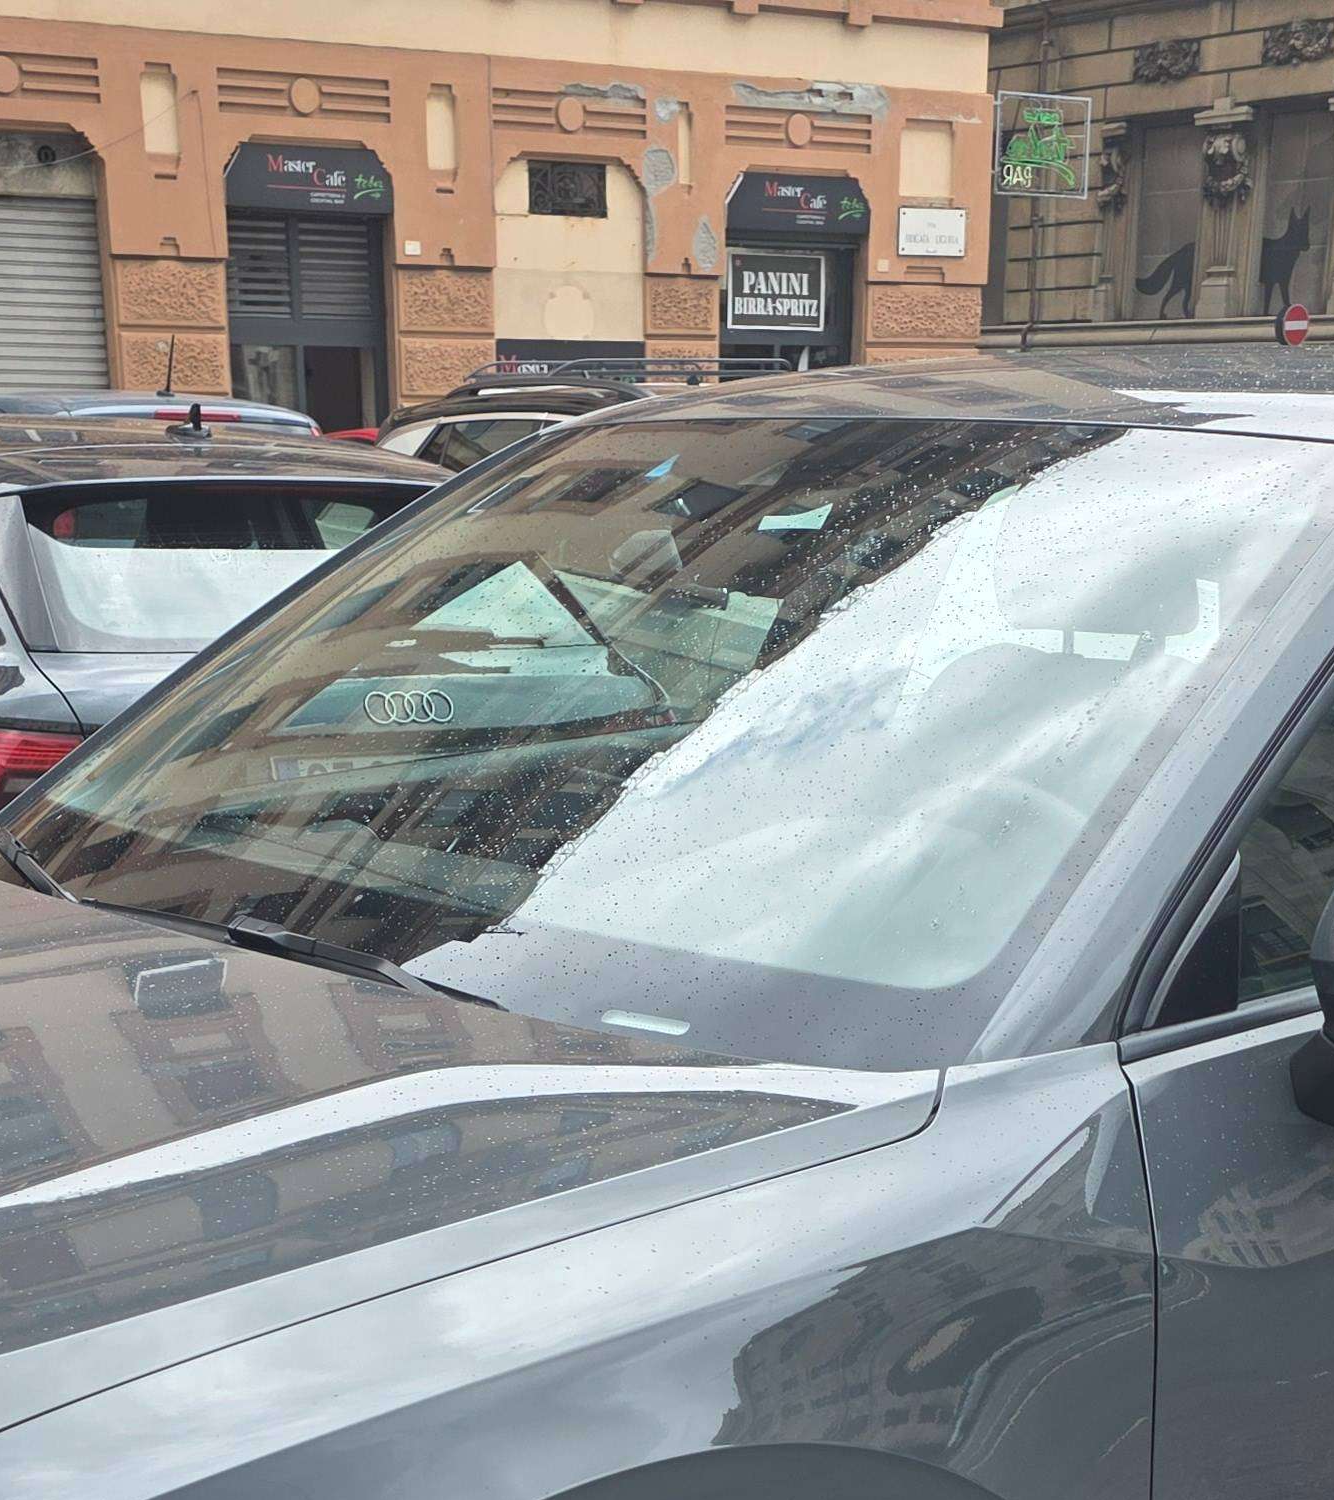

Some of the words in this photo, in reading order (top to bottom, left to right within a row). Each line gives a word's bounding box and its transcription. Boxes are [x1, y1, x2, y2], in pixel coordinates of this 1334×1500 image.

[267, 153, 317, 174] Master
[764, 181, 804, 198] Master
[742, 270, 810, 296] PANINI
[734, 296, 819, 317] BIRRA-SPRITZ
